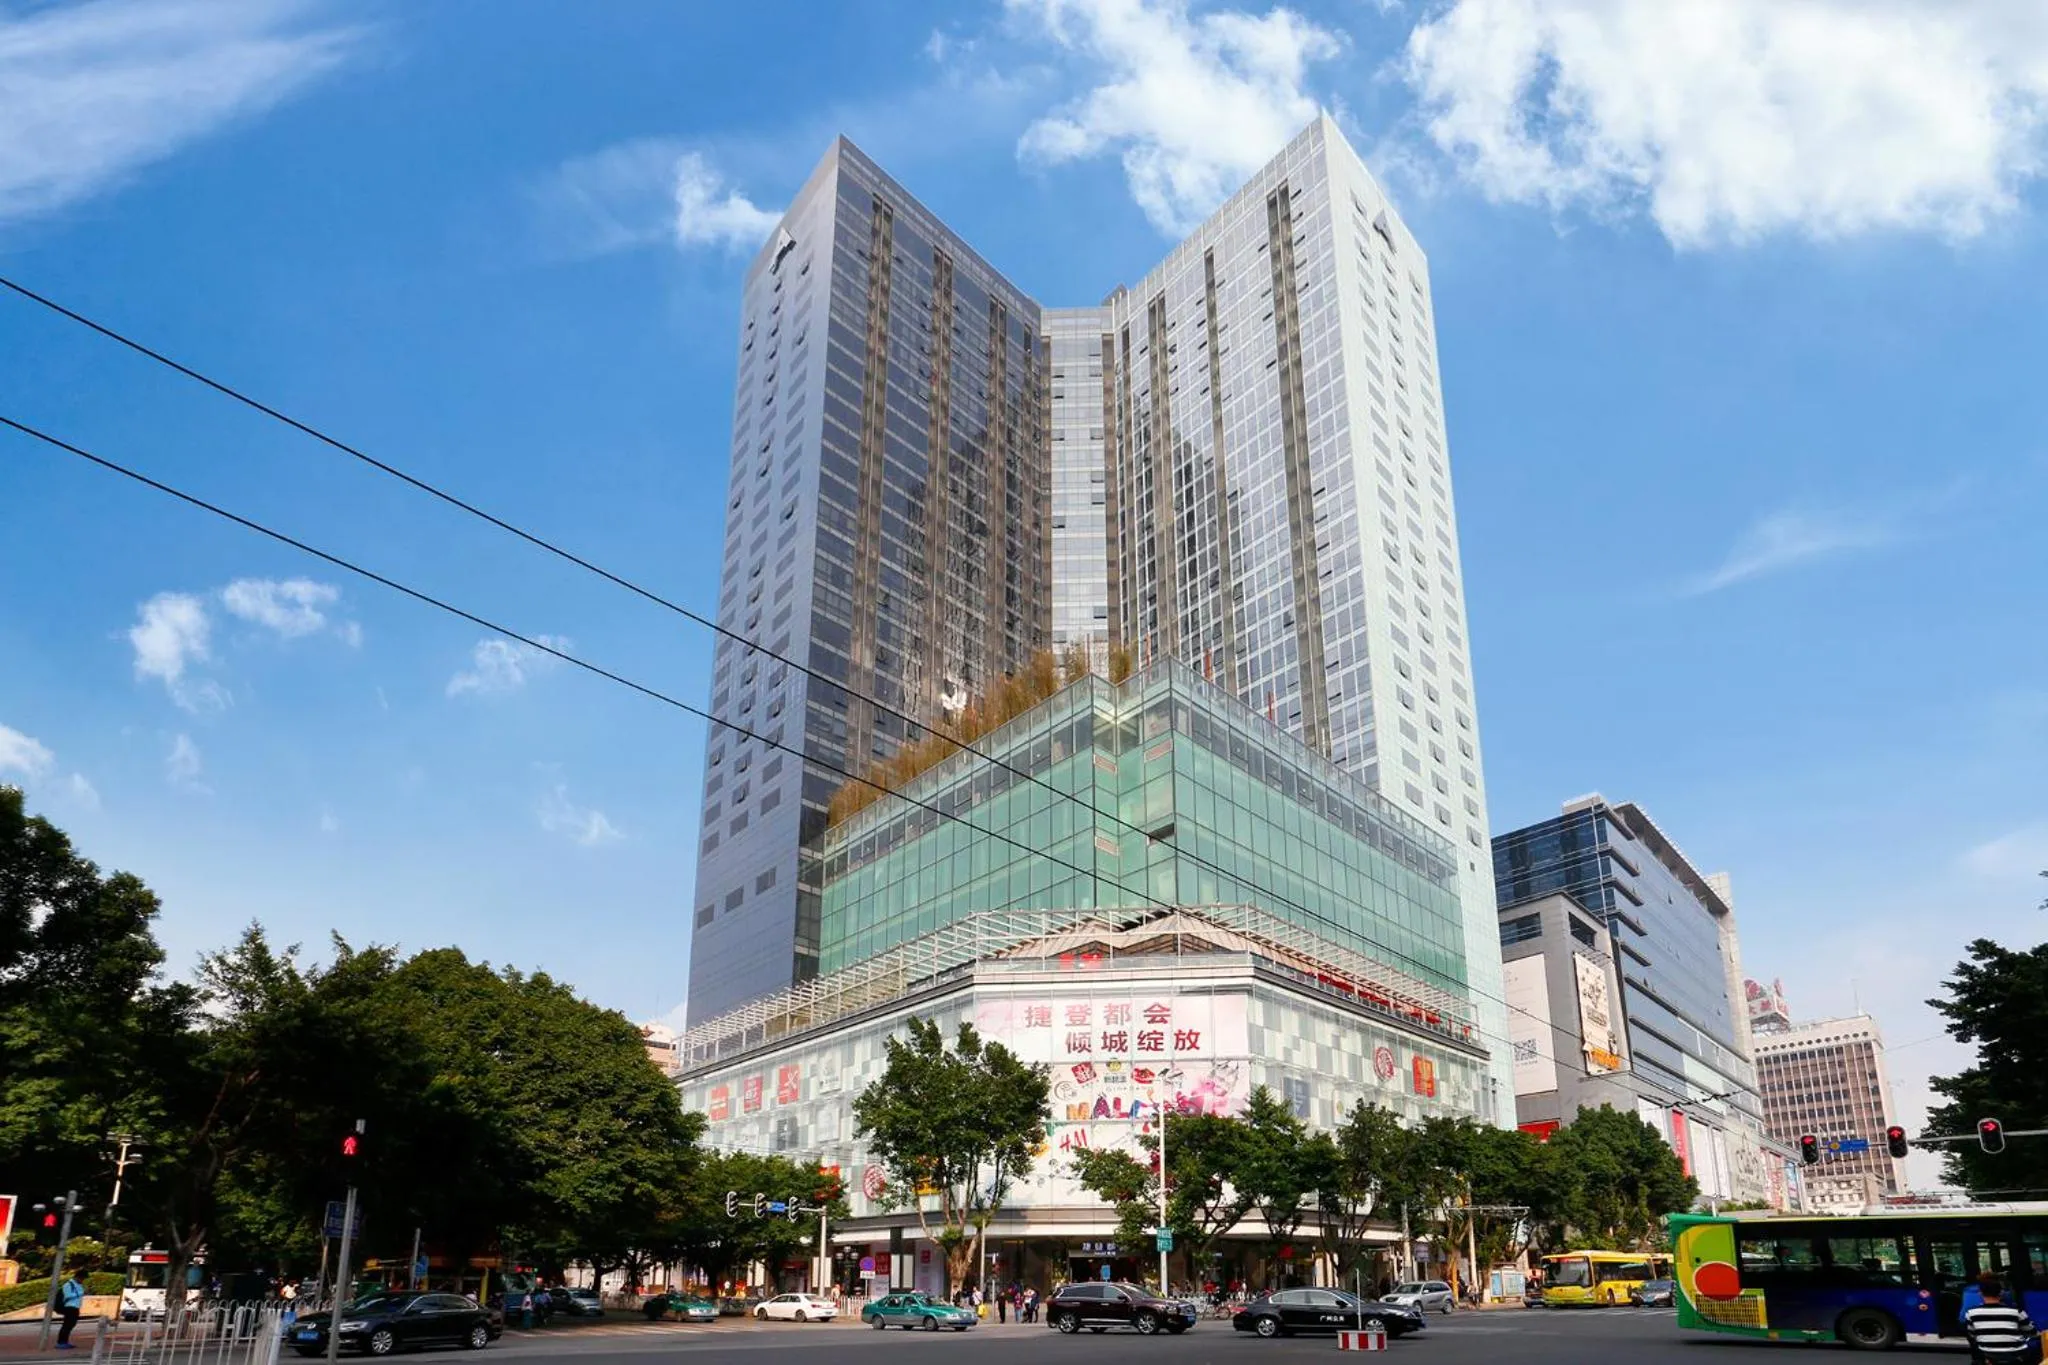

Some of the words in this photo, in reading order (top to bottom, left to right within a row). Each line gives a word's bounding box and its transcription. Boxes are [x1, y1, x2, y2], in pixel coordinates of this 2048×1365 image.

[1024, 1002, 1171, 1028] 捷登都会
[1065, 1030, 1201, 1054] 倾城绽放
